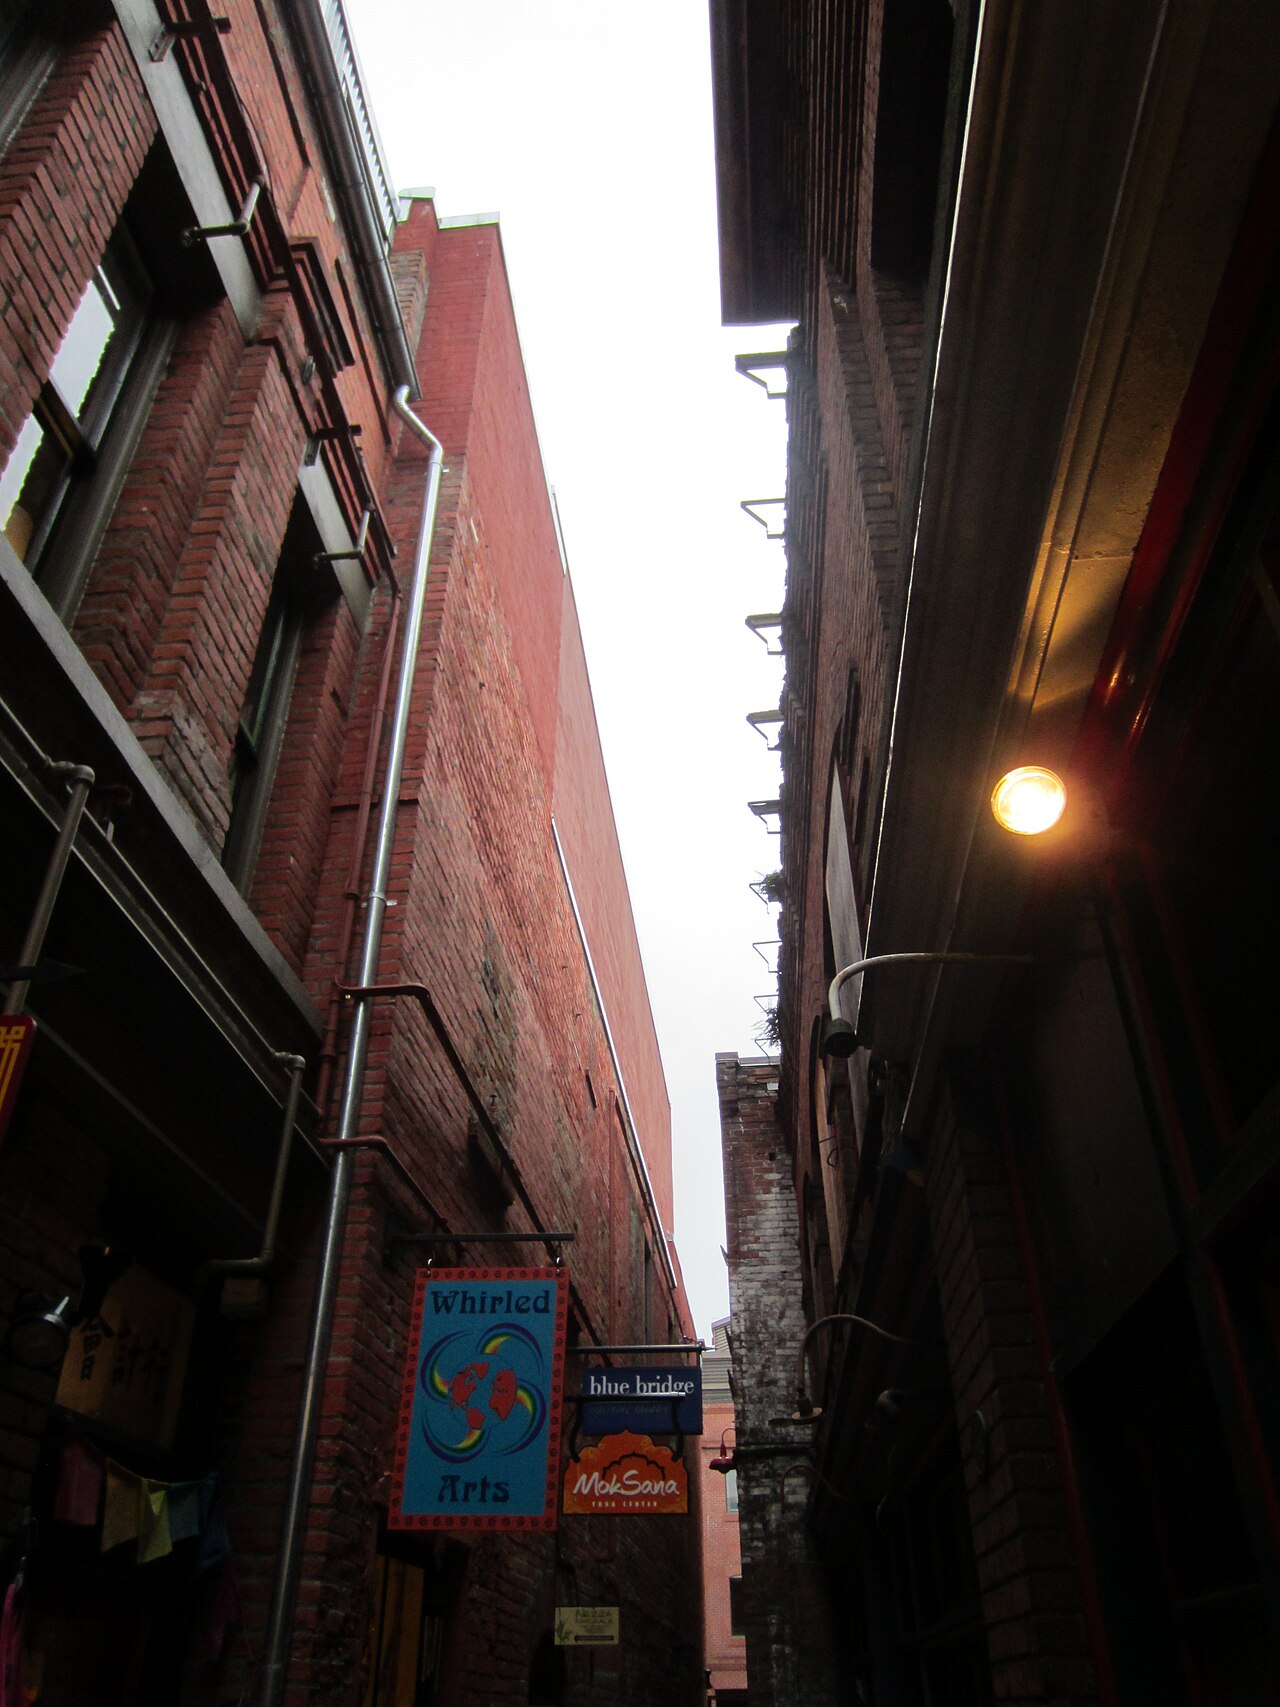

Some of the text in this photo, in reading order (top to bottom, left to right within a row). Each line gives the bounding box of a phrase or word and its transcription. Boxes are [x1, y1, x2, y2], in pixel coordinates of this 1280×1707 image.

[430, 1290, 550, 1315] Whirled
[590, 1375, 694, 1396] blue bridge
[438, 1475, 510, 1503] Arts
[573, 1470, 680, 1497] MokSana
